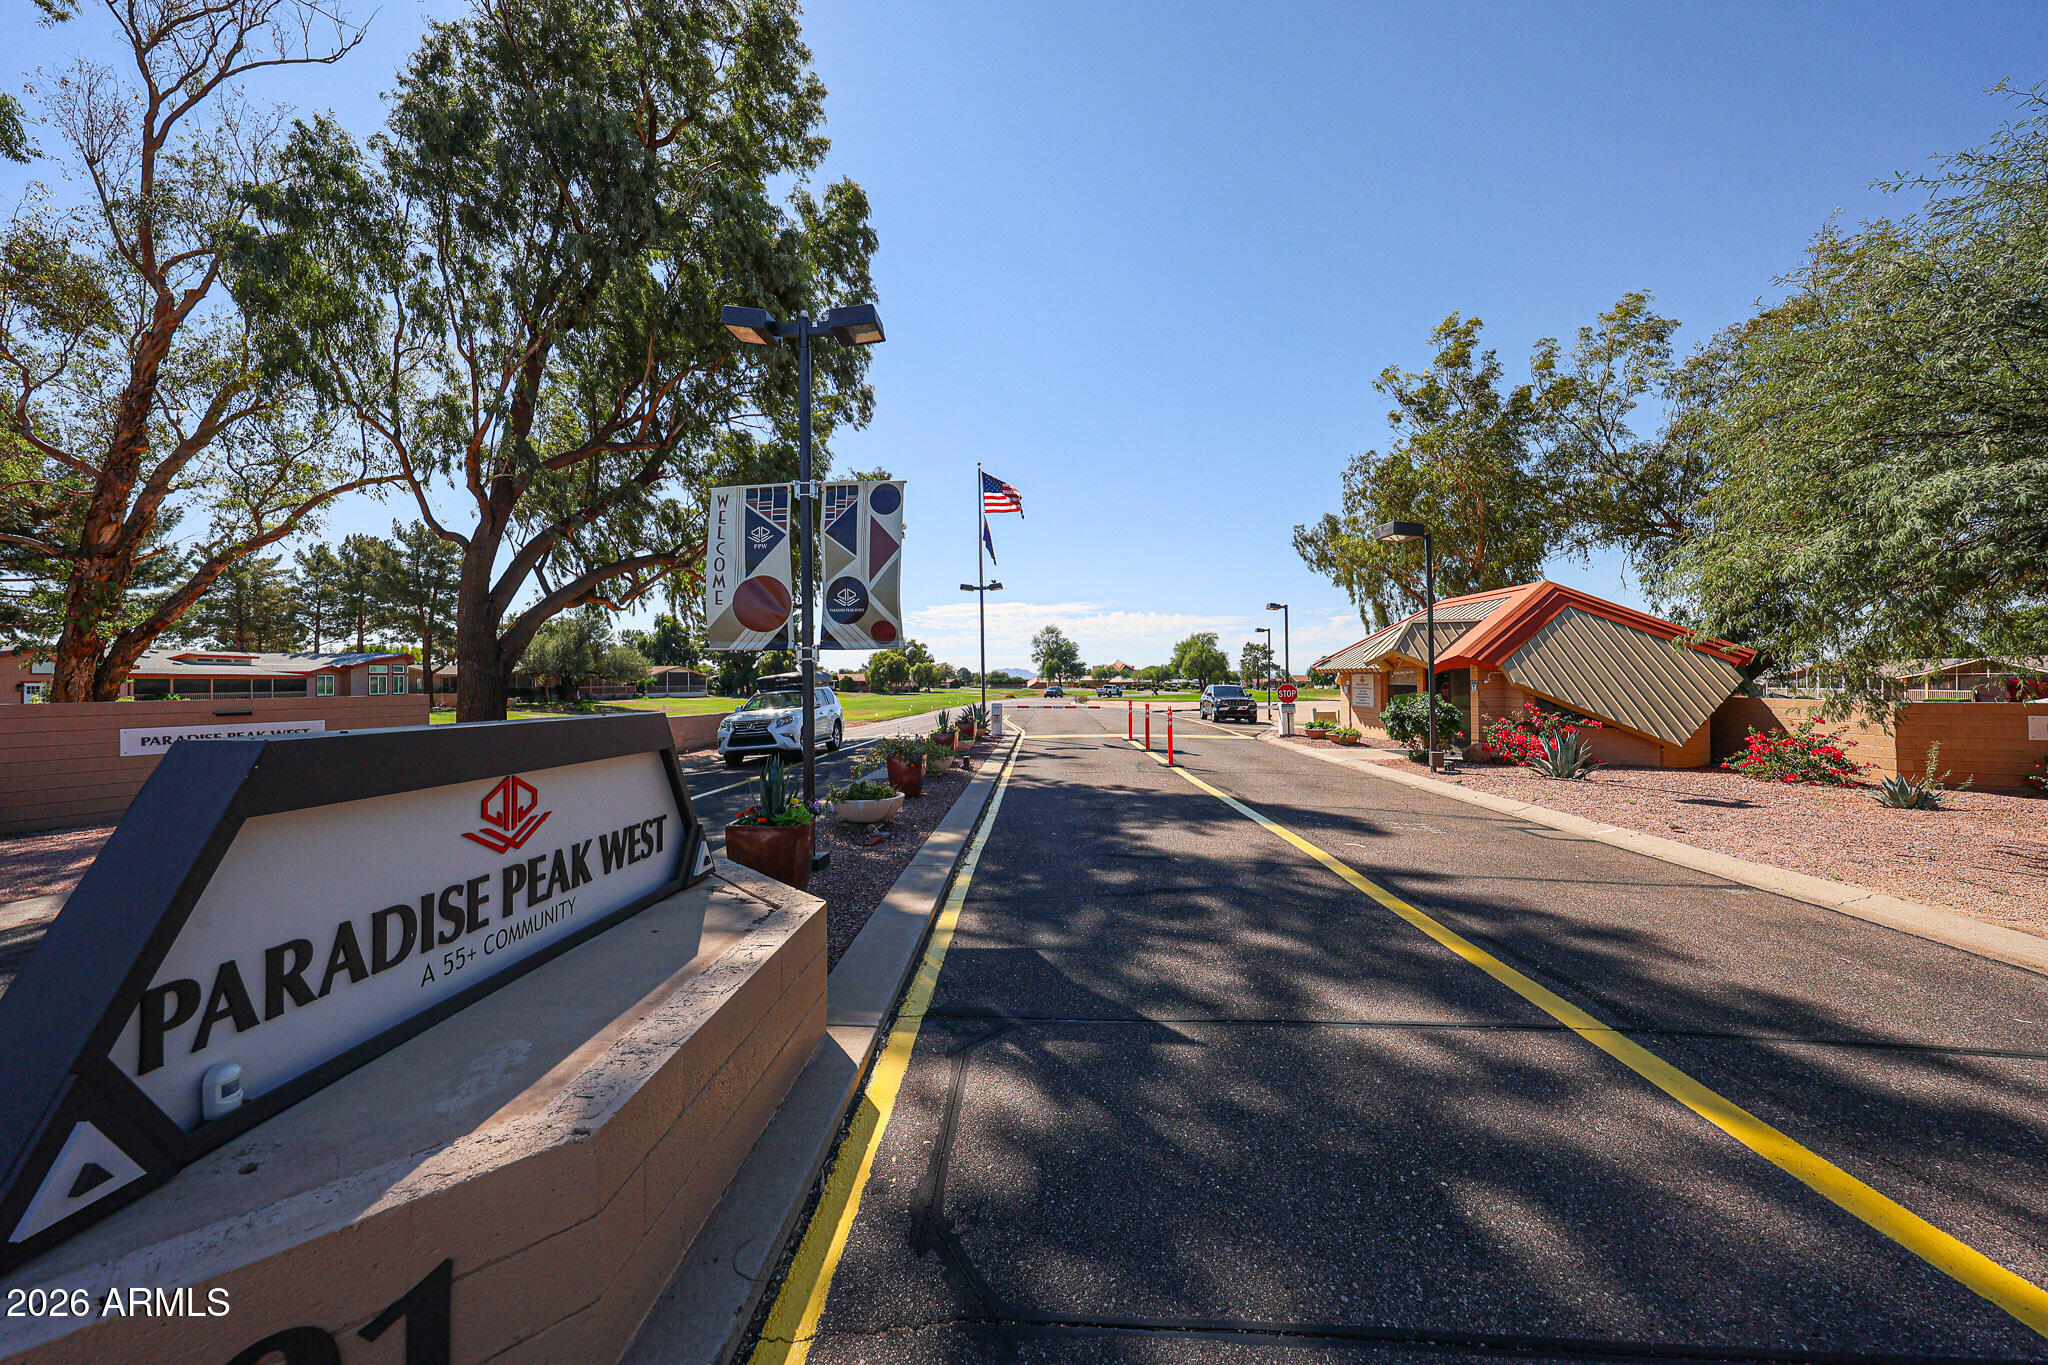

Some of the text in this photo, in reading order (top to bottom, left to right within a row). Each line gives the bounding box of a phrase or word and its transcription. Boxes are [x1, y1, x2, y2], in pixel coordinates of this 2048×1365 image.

[712, 494, 729, 606] WELCOME
[1278, 690, 1296, 698] STOP
[137, 814, 668, 1076] PARADISE PEAK WEST
[420, 896, 577, 988] A 55+ COMMUNITY
[220, 1257, 454, 1365] 1
